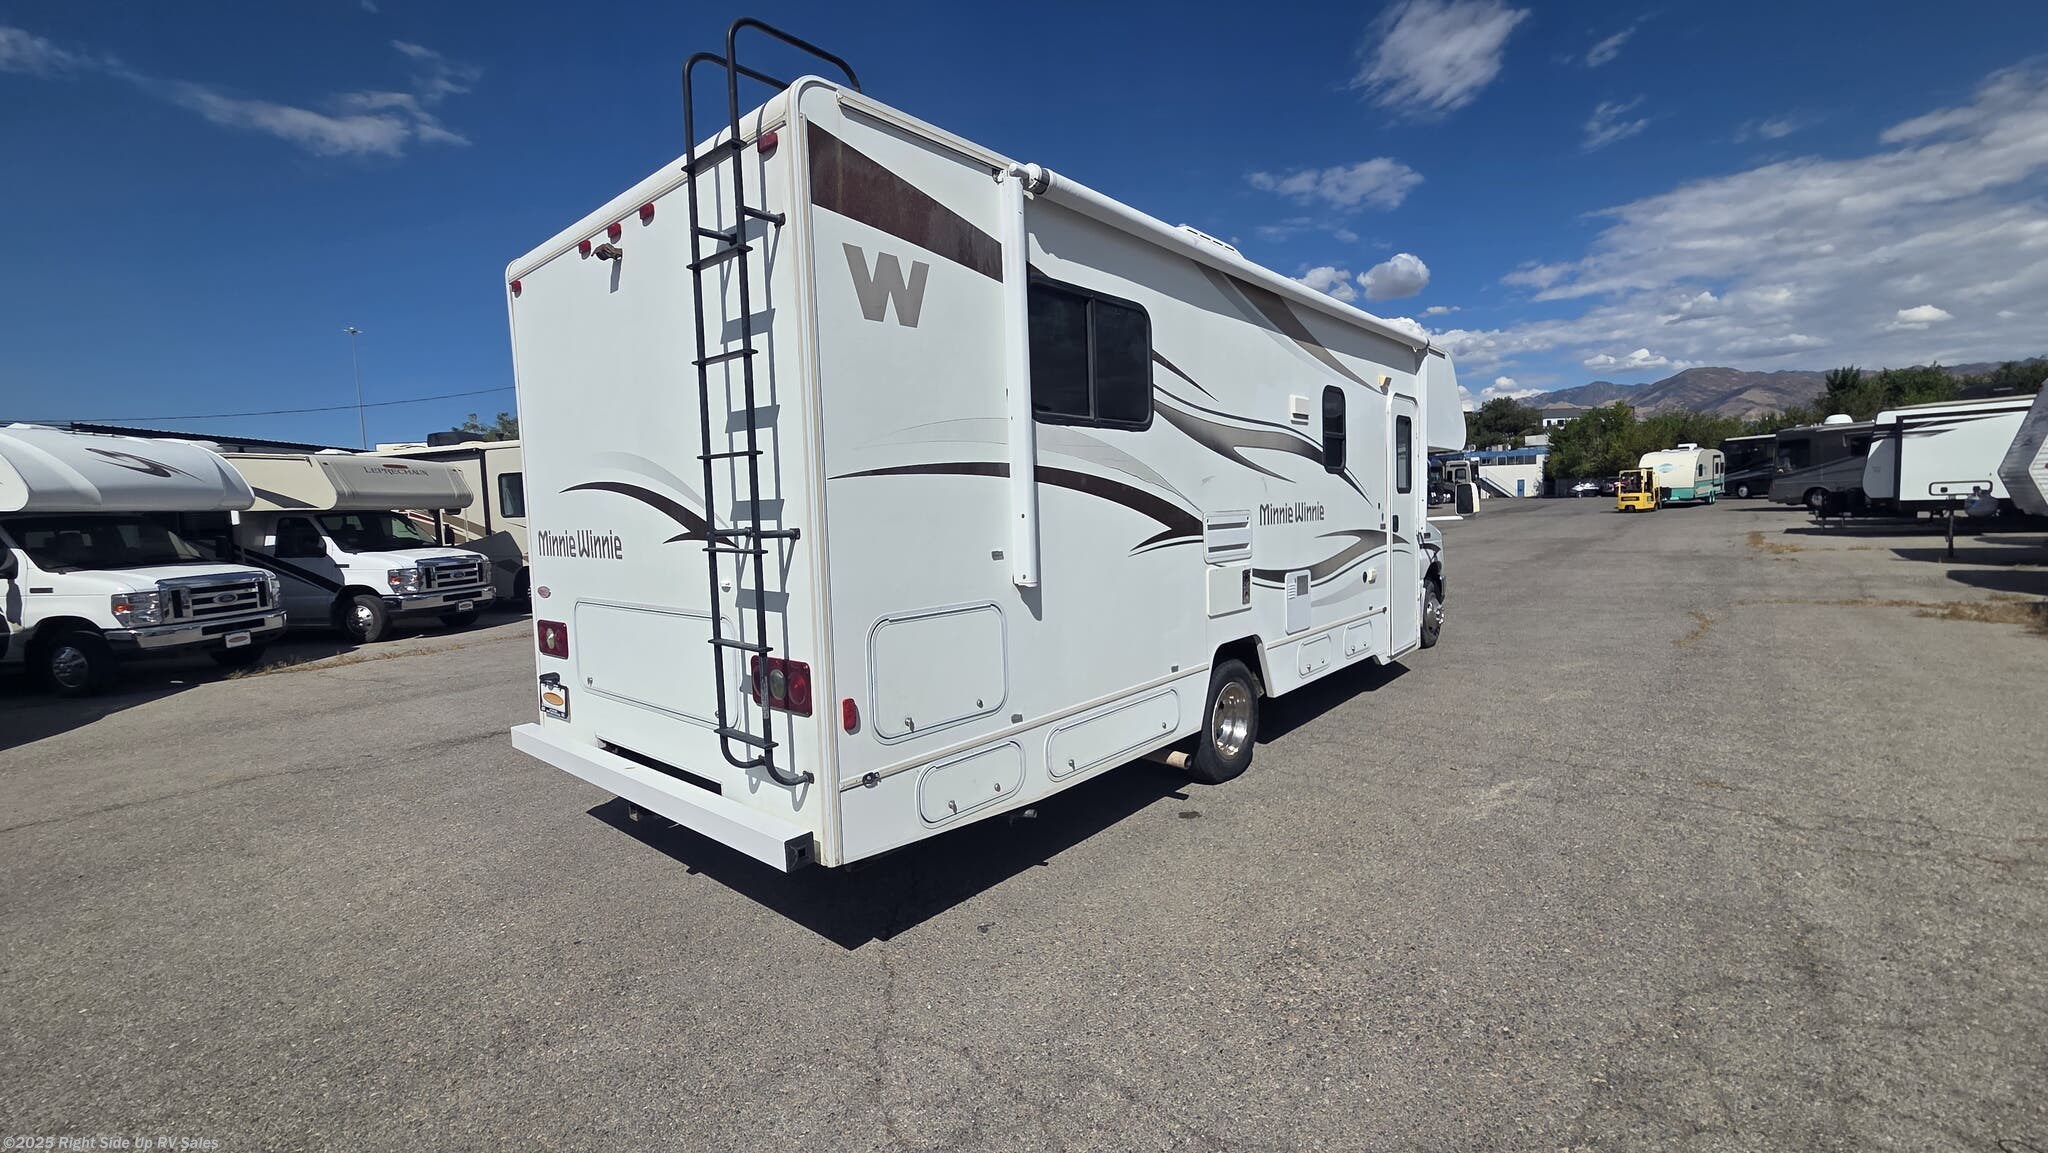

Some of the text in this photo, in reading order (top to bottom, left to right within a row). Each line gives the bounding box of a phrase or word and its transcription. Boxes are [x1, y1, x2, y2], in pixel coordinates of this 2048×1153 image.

[842, 242, 930, 328] W
[1259, 501, 1325, 526] Minnie Winnie
[538, 529, 623, 560] Minnie Winnie
